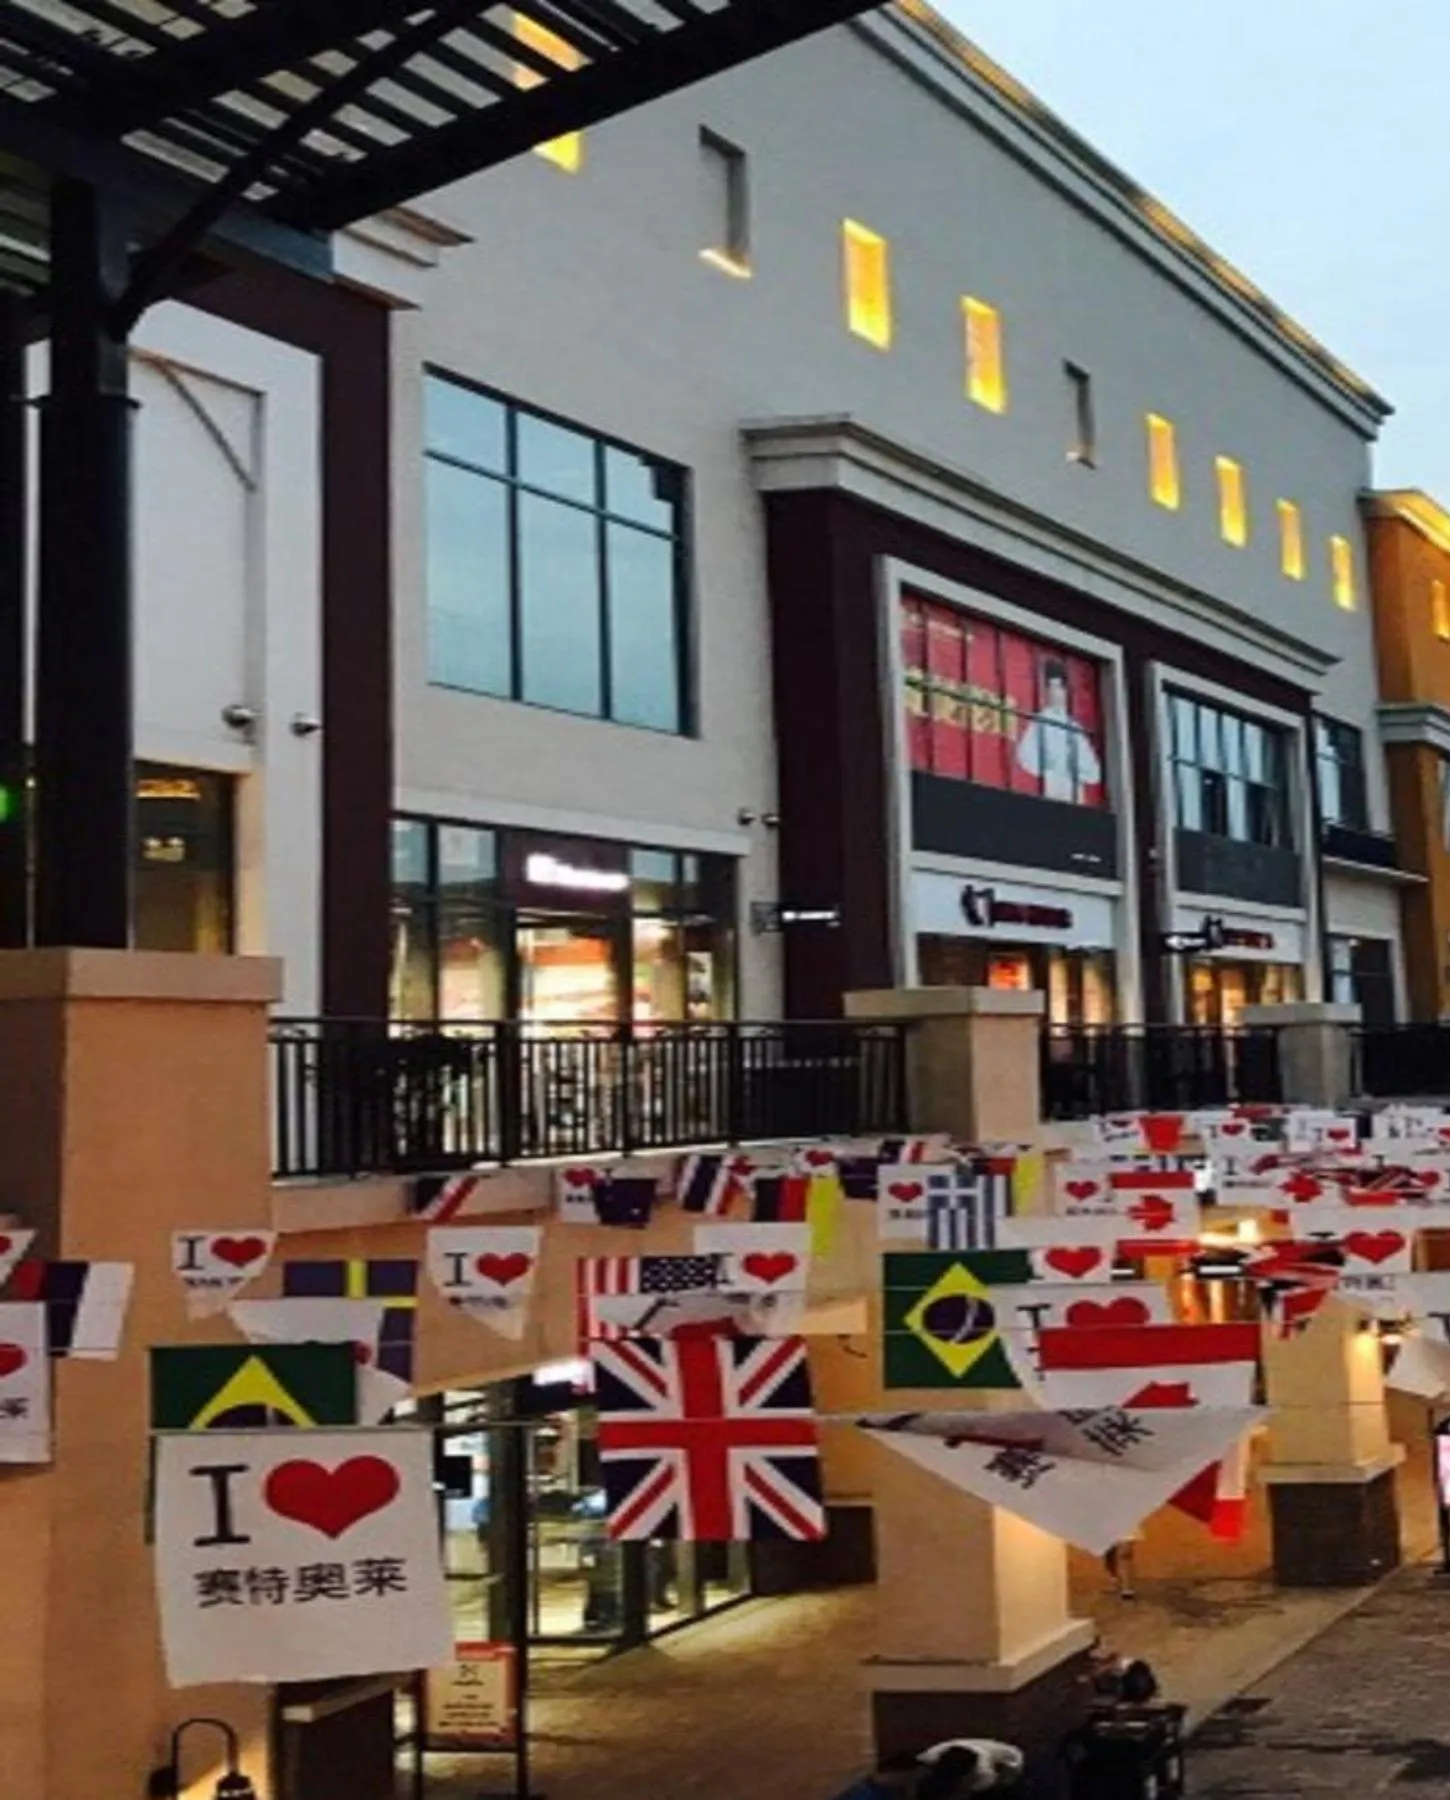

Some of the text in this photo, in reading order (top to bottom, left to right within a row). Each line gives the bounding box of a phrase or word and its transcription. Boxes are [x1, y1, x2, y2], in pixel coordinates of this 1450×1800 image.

[177, 1236, 206, 1270] I
[443, 1252, 472, 1286] I
[189, 1463, 251, 1547] I
[193, 1557, 408, 1609] 赛特奥莱
